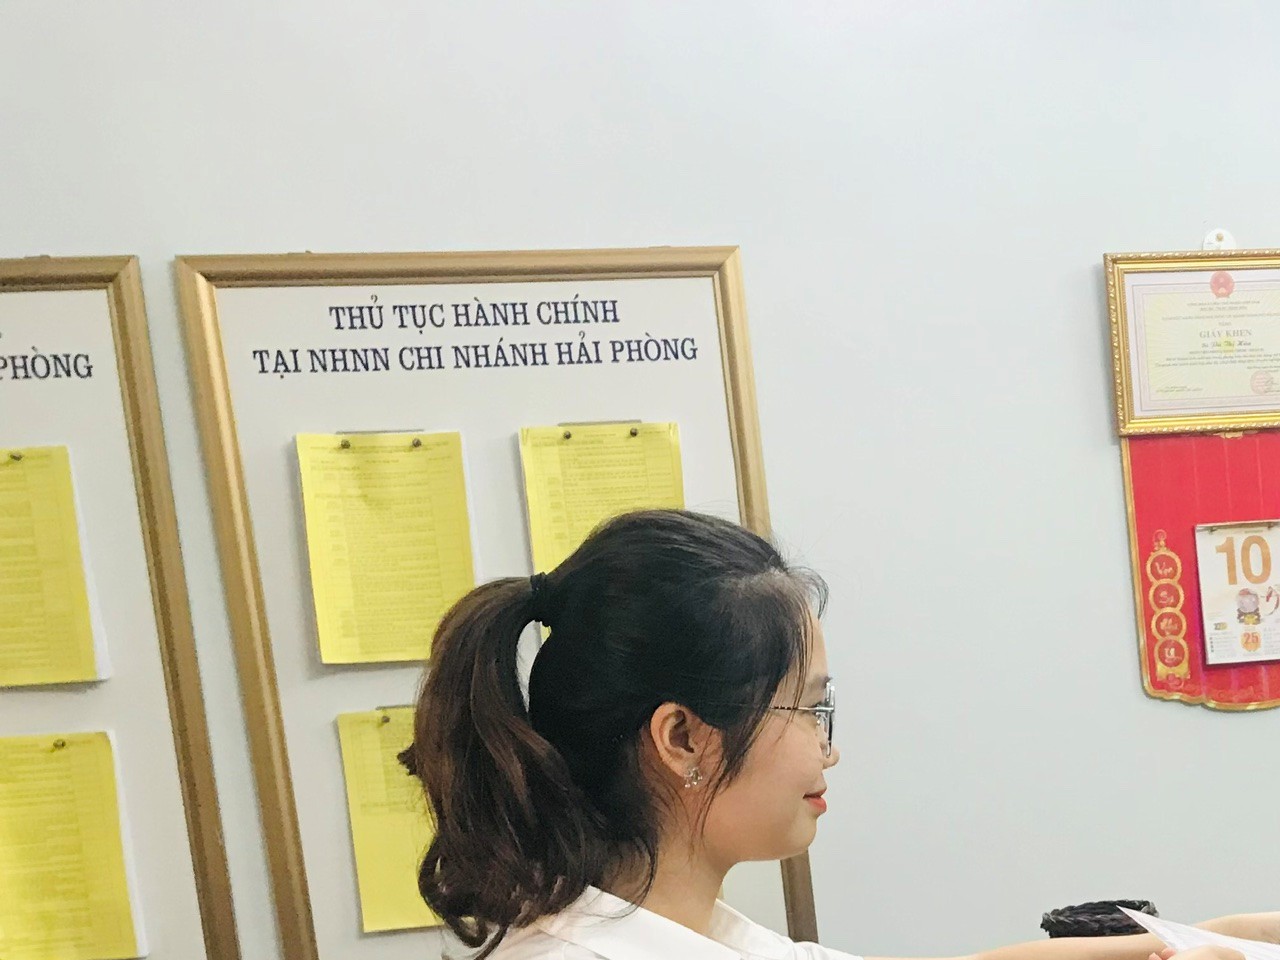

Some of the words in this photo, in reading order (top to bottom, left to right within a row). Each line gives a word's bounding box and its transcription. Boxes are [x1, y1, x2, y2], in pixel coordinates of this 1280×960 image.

[328, 294, 384, 330] THỦ
[392, 303, 446, 336] TỤC
[452, 296, 531, 328] HÀNH
[536, 293, 620, 325] CHÍNH
[252, 349, 302, 379] TẠI
[306, 347, 391, 373] NHNN
[398, 346, 445, 371] CHI
[451, 336, 550, 369] NHÁNH
[554, 331, 603, 366] HẢI
[609, 331, 698, 363] PHÒNG
[1214, 535, 1273, 585] 10
[1243, 631, 1259, 646] 25
